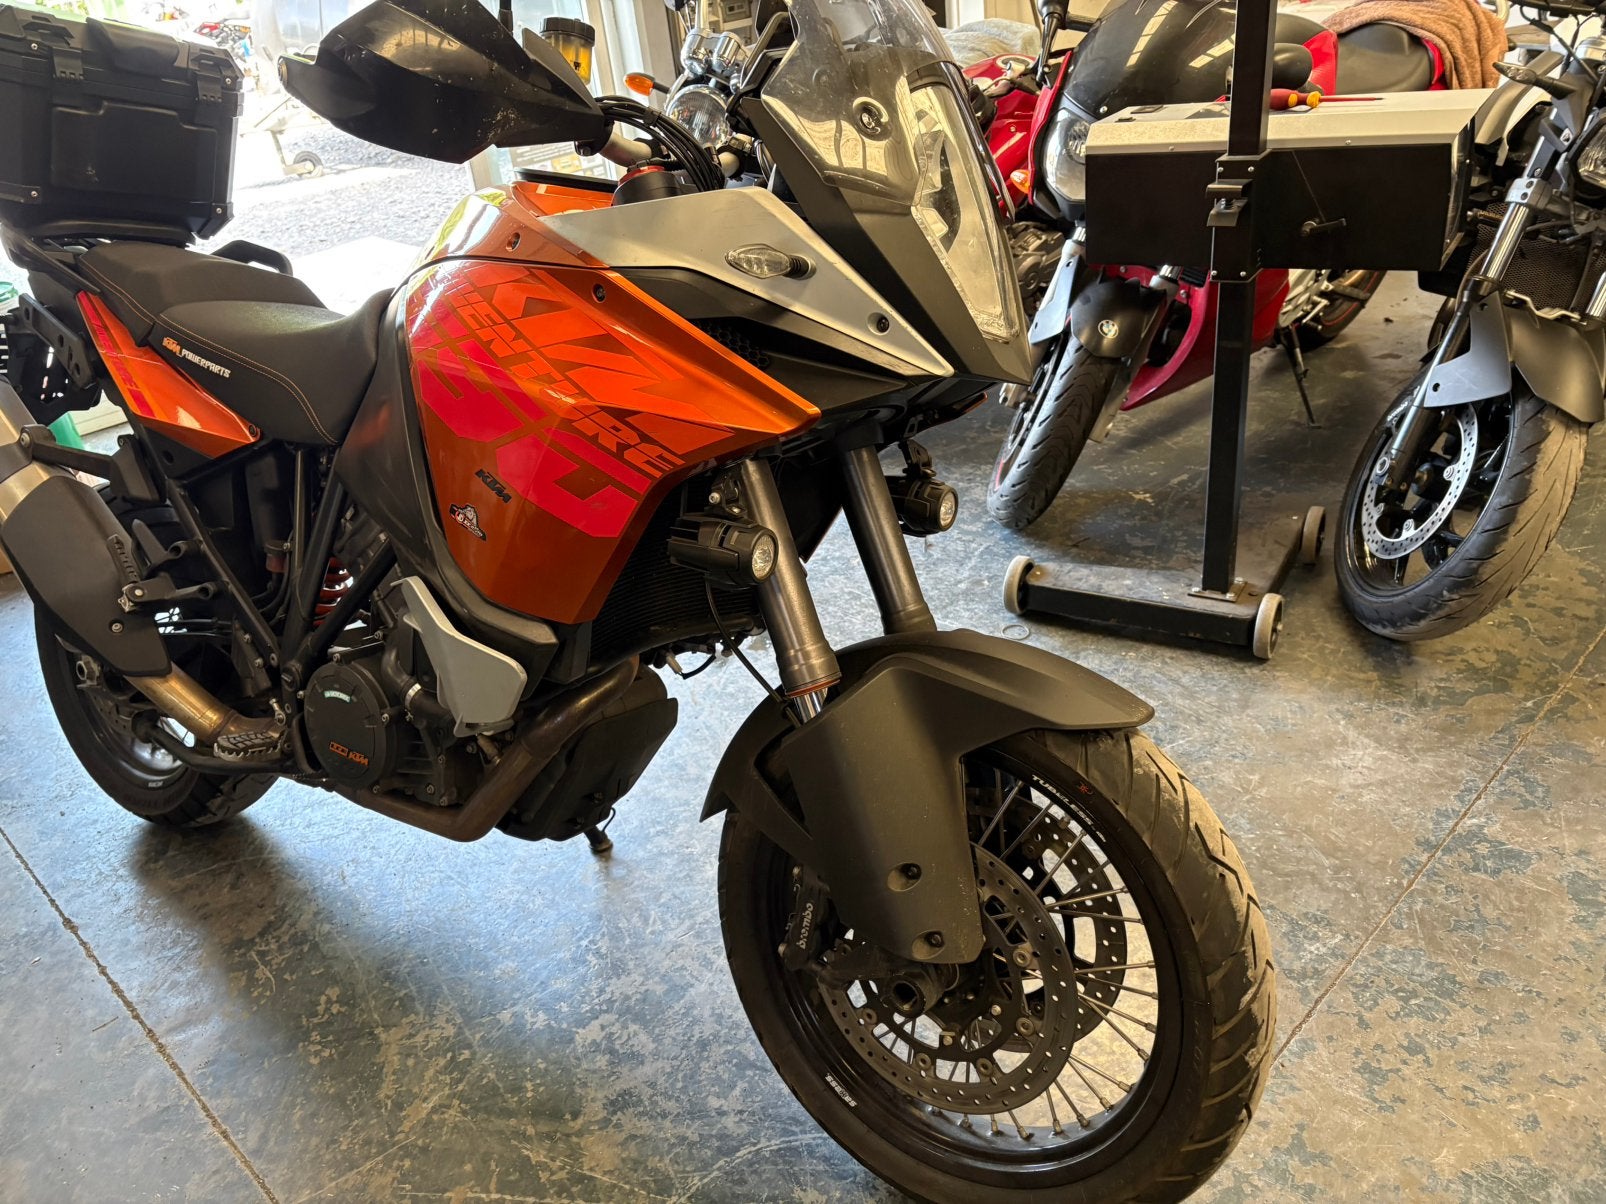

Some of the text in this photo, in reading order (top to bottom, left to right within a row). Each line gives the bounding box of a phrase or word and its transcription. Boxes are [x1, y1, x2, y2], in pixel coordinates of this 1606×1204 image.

[181, 348, 232, 378] POWERPARTS
[475, 469, 512, 503] KTM
[796, 902, 813, 950] brembo
